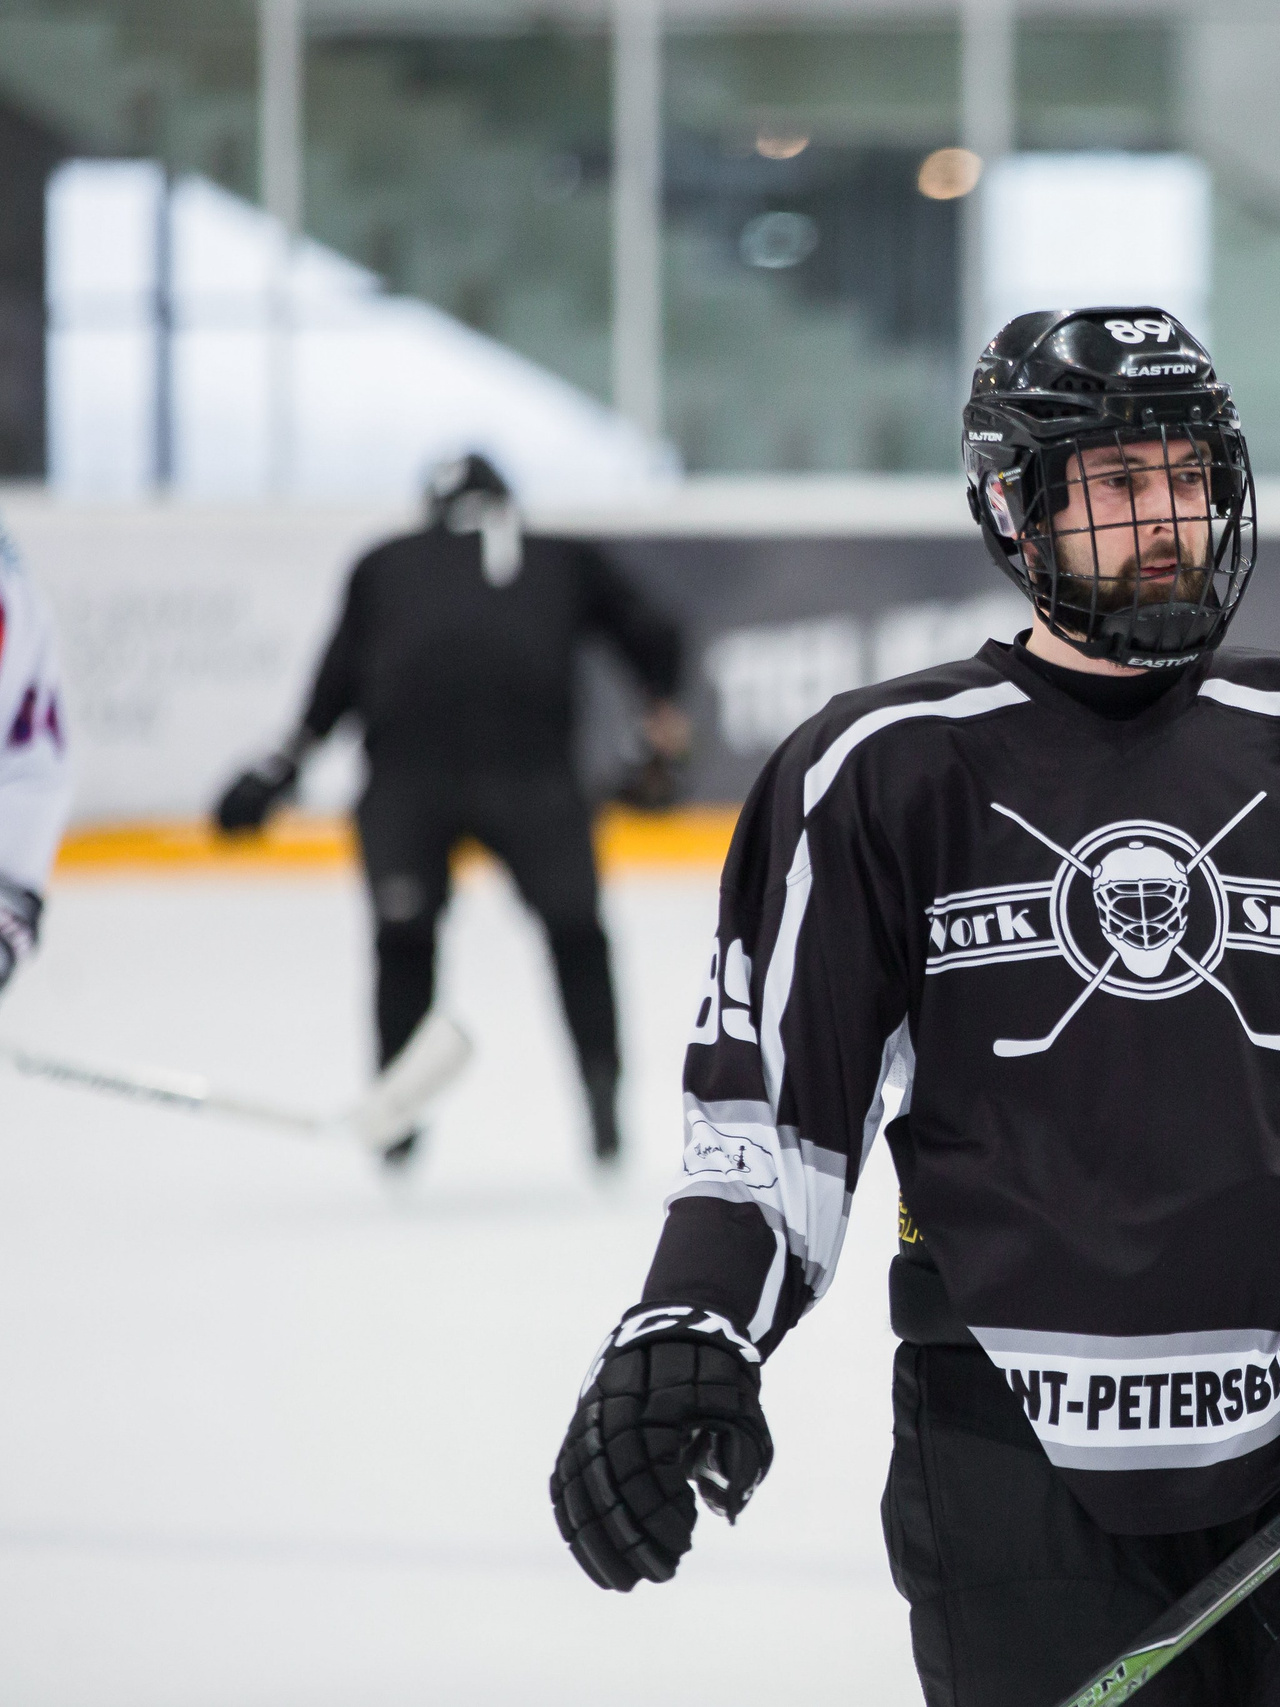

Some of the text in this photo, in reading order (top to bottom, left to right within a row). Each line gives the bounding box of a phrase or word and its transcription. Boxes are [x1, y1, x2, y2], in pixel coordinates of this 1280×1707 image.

[1104, 319, 1171, 344] 89
[1126, 364, 1198, 378] EASTON
[968, 431, 1003, 442] EASTON
[1127, 653, 1199, 668] EASTON
